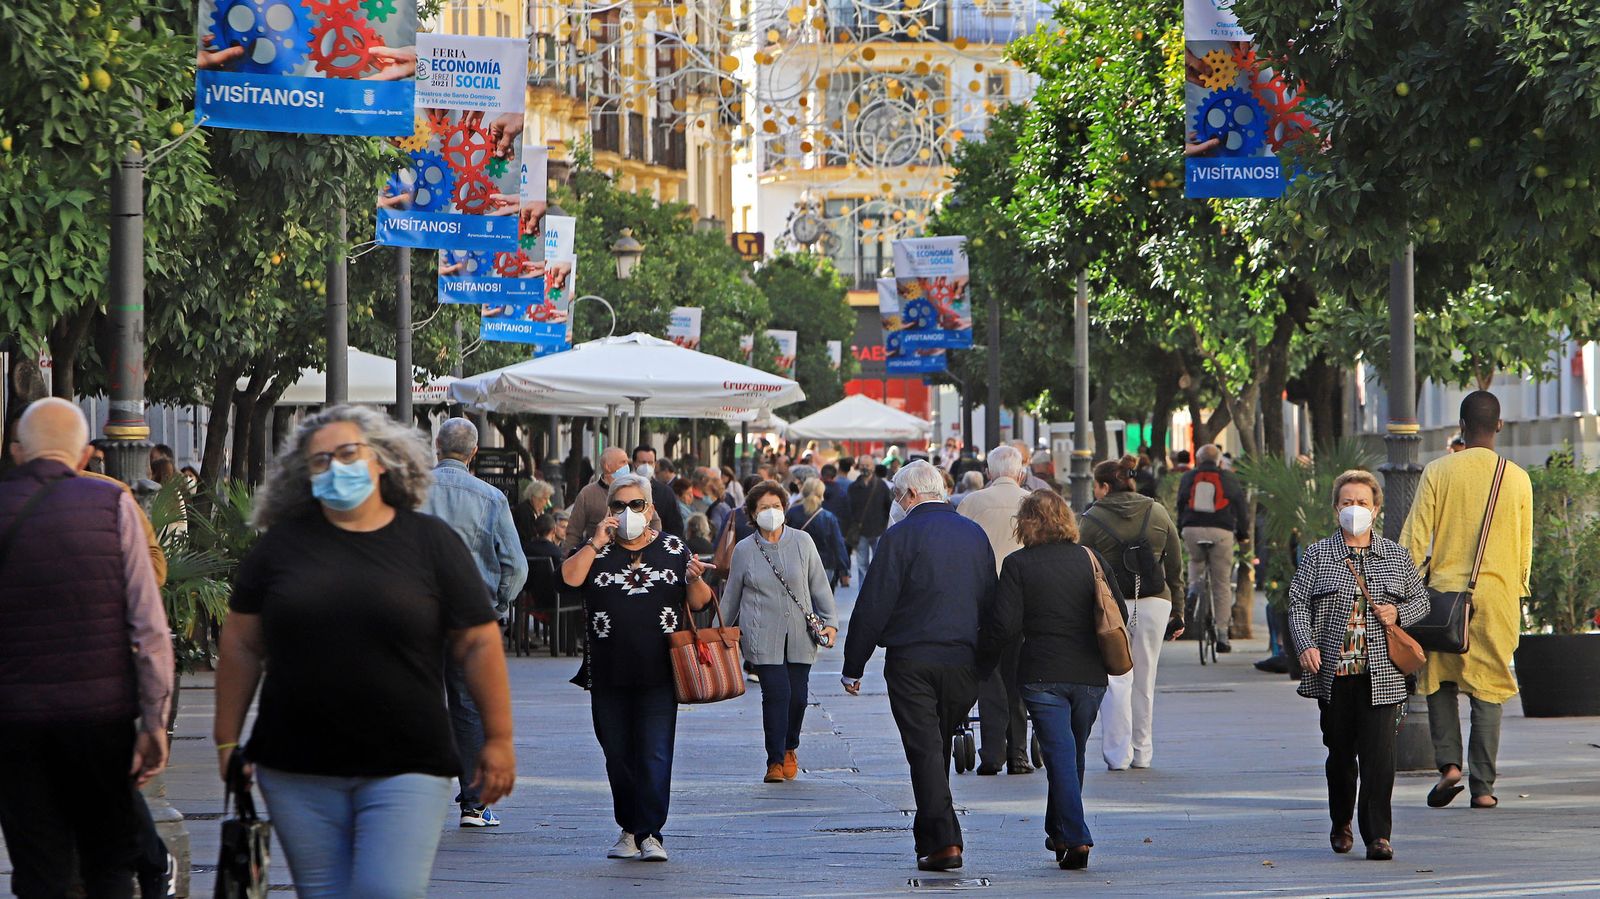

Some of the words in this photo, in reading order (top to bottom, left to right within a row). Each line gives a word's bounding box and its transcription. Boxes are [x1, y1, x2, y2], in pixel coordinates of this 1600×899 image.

[433, 48, 466, 58] FERIA
[431, 59, 501, 75] ECONOMÍA
[455, 75, 501, 90] SOCIAL
[205, 82, 325, 108] ¡VISÍTANOS!
[470, 93, 496, 101] Domingo
[448, 99, 478, 107] noviembre
[1192, 164, 1279, 182] ¡VISÍTANOS!
[383, 217, 461, 234] ¡VISÍTANOS!
[916, 248, 954, 258] ECONOMÍA
[444, 281, 502, 293] ¡VISÍTANOS!
[484, 321, 532, 334] ¡VISÍTANOS!
[723, 380, 782, 393] Cruzcampo
